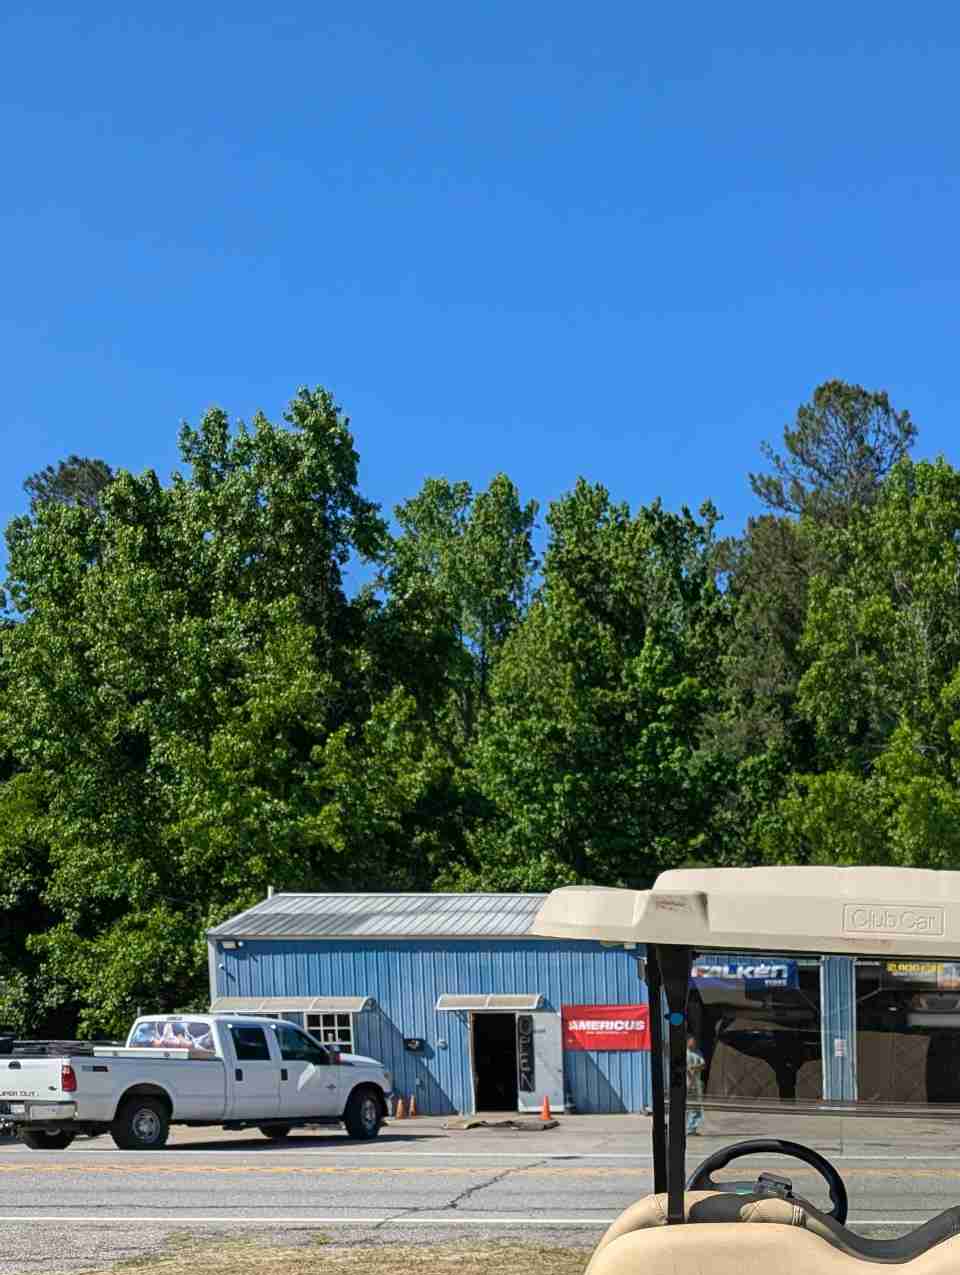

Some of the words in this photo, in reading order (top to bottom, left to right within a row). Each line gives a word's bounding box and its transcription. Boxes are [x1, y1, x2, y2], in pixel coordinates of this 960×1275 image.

[851, 908, 897, 929] Club
[901, 911, 937, 930] Car
[568, 1019, 646, 1031] AMERICUS
